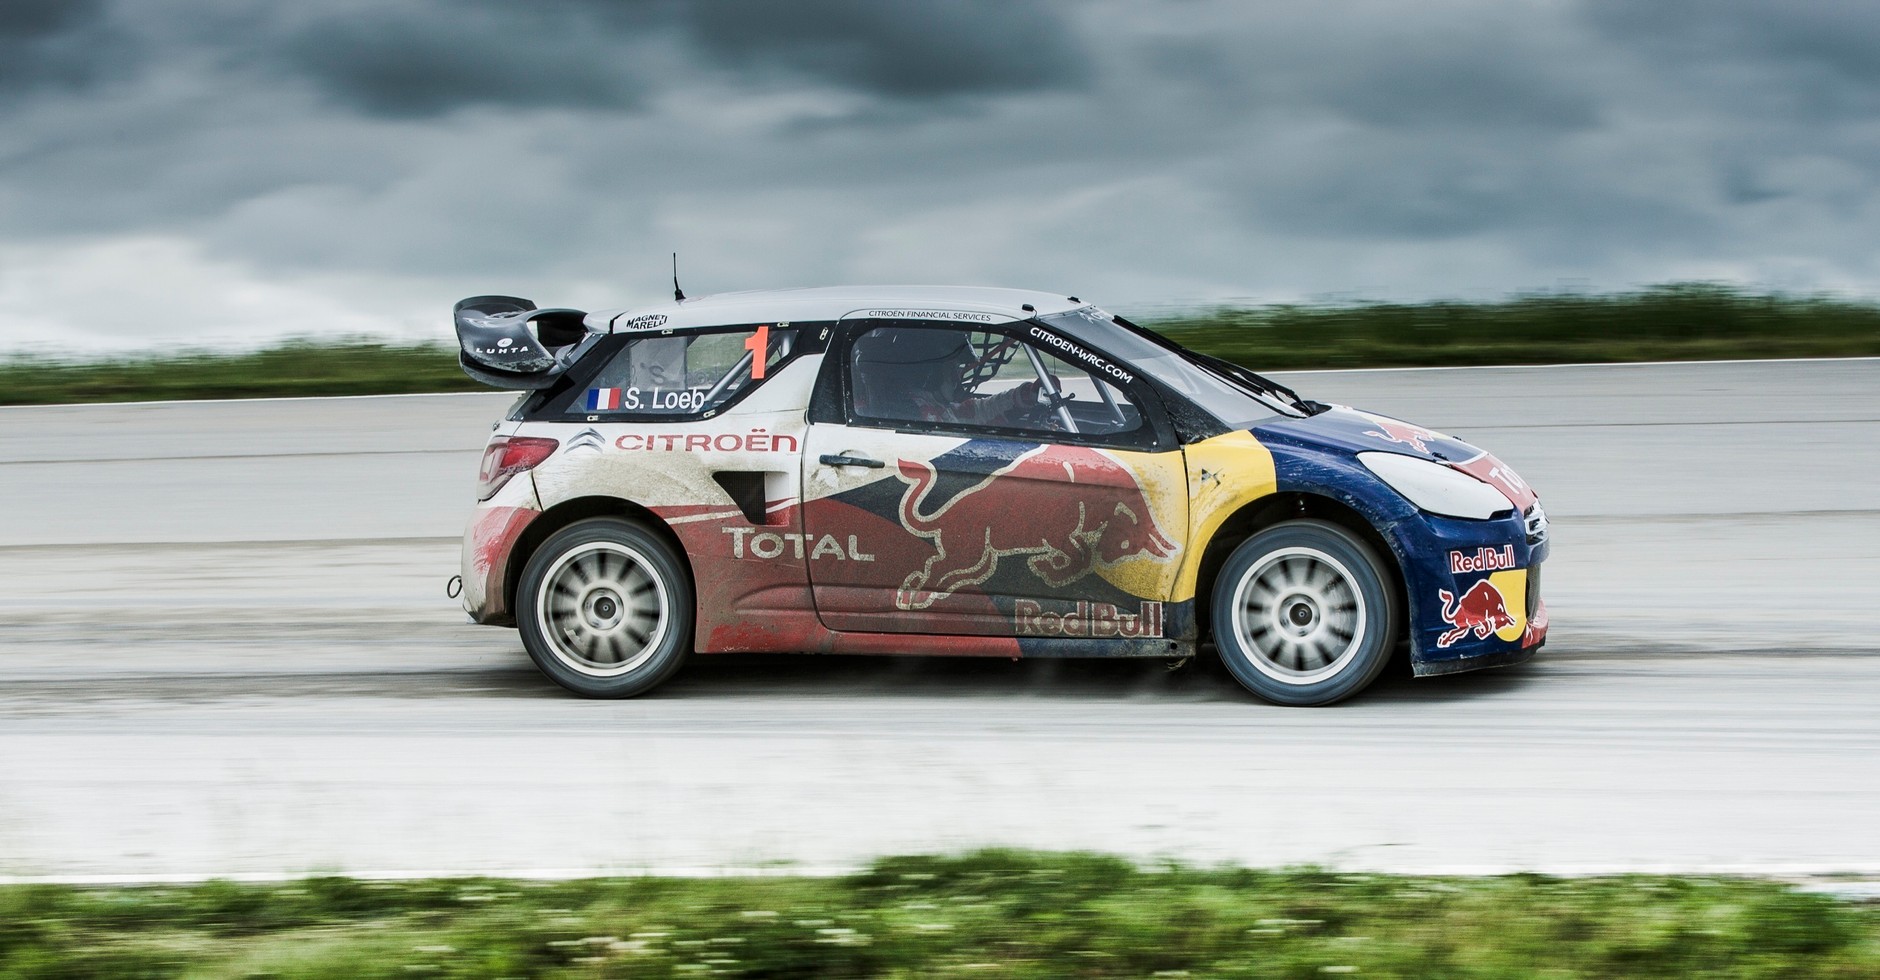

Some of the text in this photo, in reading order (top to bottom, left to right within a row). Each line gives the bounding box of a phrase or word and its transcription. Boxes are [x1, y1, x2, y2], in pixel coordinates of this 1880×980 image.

[906, 311, 951, 319] FINANCIAL
[953, 312, 991, 321] SERVICES
[475, 346, 529, 354] LUHTA
[744, 325, 769, 379] 1
[1030, 327, 1133, 384] CITROEN-WRC.COM
[624, 386, 705, 410] S. Loeb
[1450, 544, 1516, 574] Red Bull
[1015, 599, 1163, 638] Red Bull
